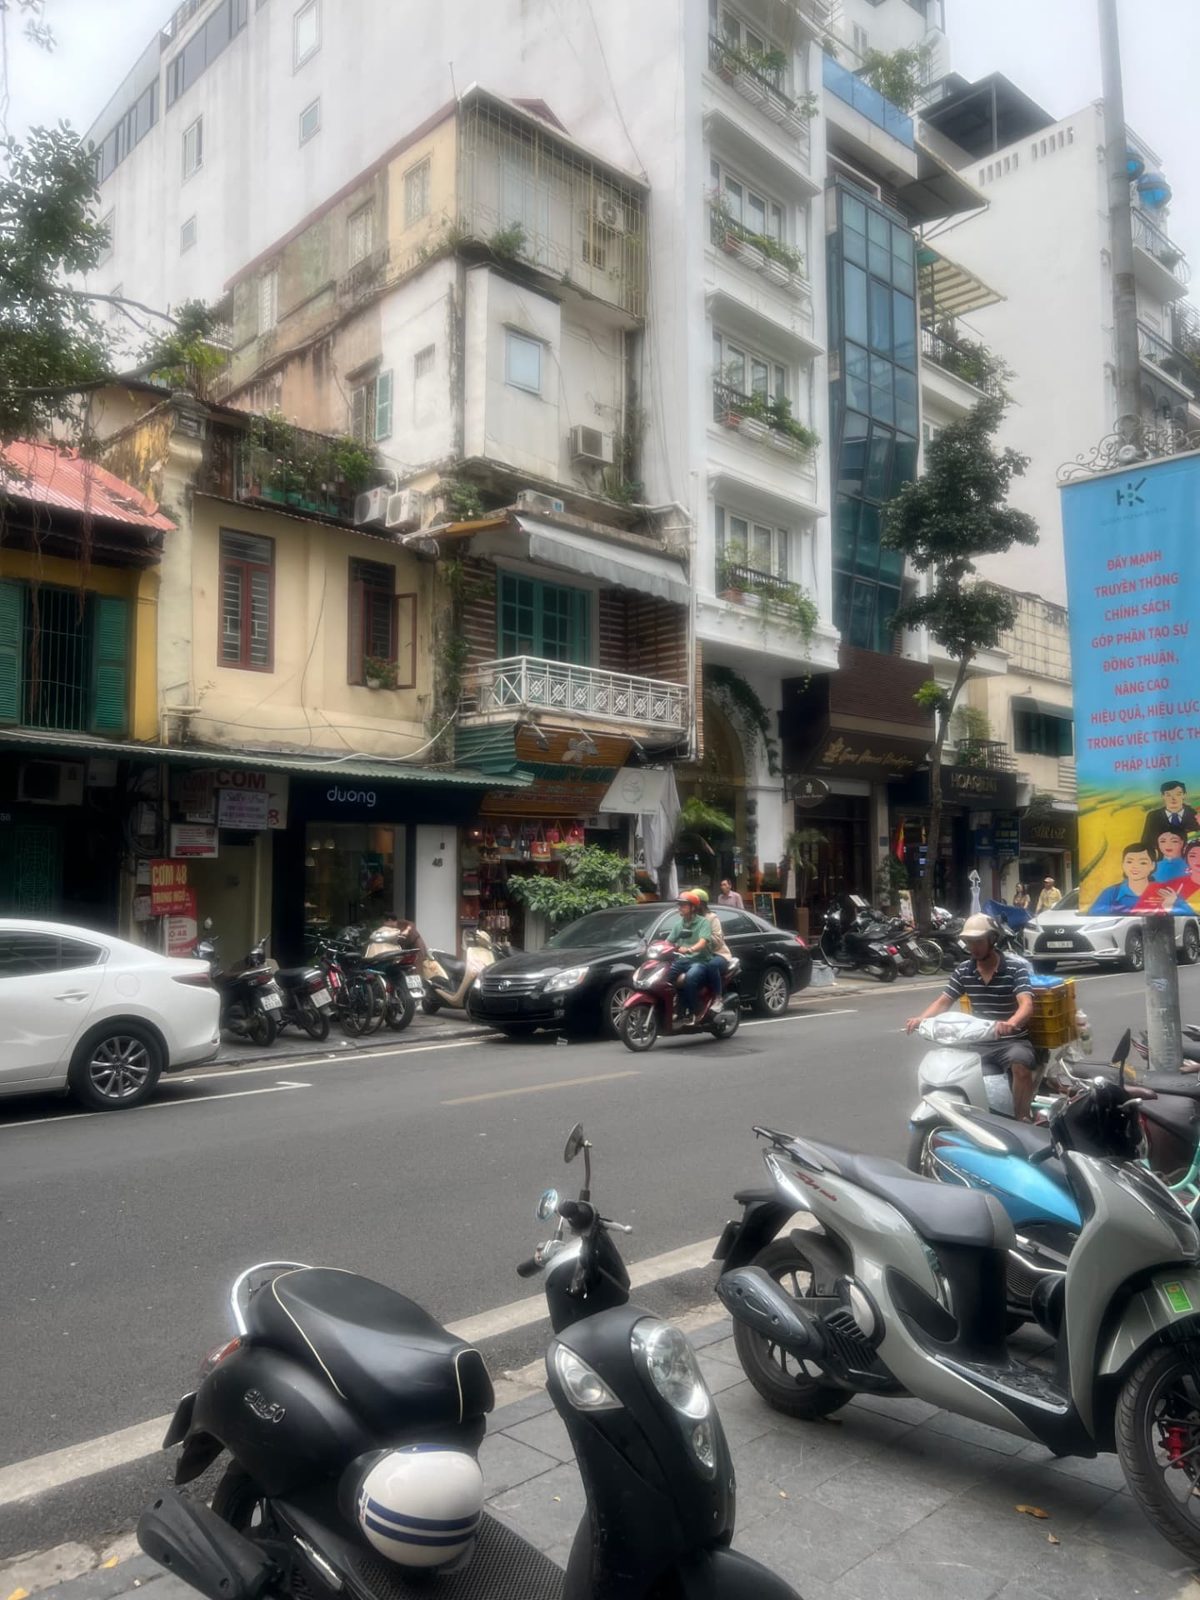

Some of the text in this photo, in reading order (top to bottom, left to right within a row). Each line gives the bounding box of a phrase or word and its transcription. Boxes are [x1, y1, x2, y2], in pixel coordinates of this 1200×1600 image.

[1129, 550, 1162, 568] MẠNH
[1094, 572, 1179, 598] TRUYỀN THÔNG
[1104, 597, 1171, 622] CHÍNH SÁCH
[1091, 632, 1114, 648] GÓP
[1148, 624, 1170, 642] TẠO
[1173, 620, 1190, 639] SỰ
[1103, 655, 1134, 673] ĐỒNG
[1114, 677, 1169, 696] NÂNG CAO
[1091, 708, 1115, 727] HIỆU
[1147, 701, 1174, 719] HIỆU
[1087, 734, 1124, 750] TRONG
[1127, 730, 1150, 749] VIỆC
[1152, 726, 1184, 744] THỰC
[1114, 756, 1143, 772] PHÁP
[1145, 754, 1172, 772] LUẬT
[326, 785, 376, 807] duong
